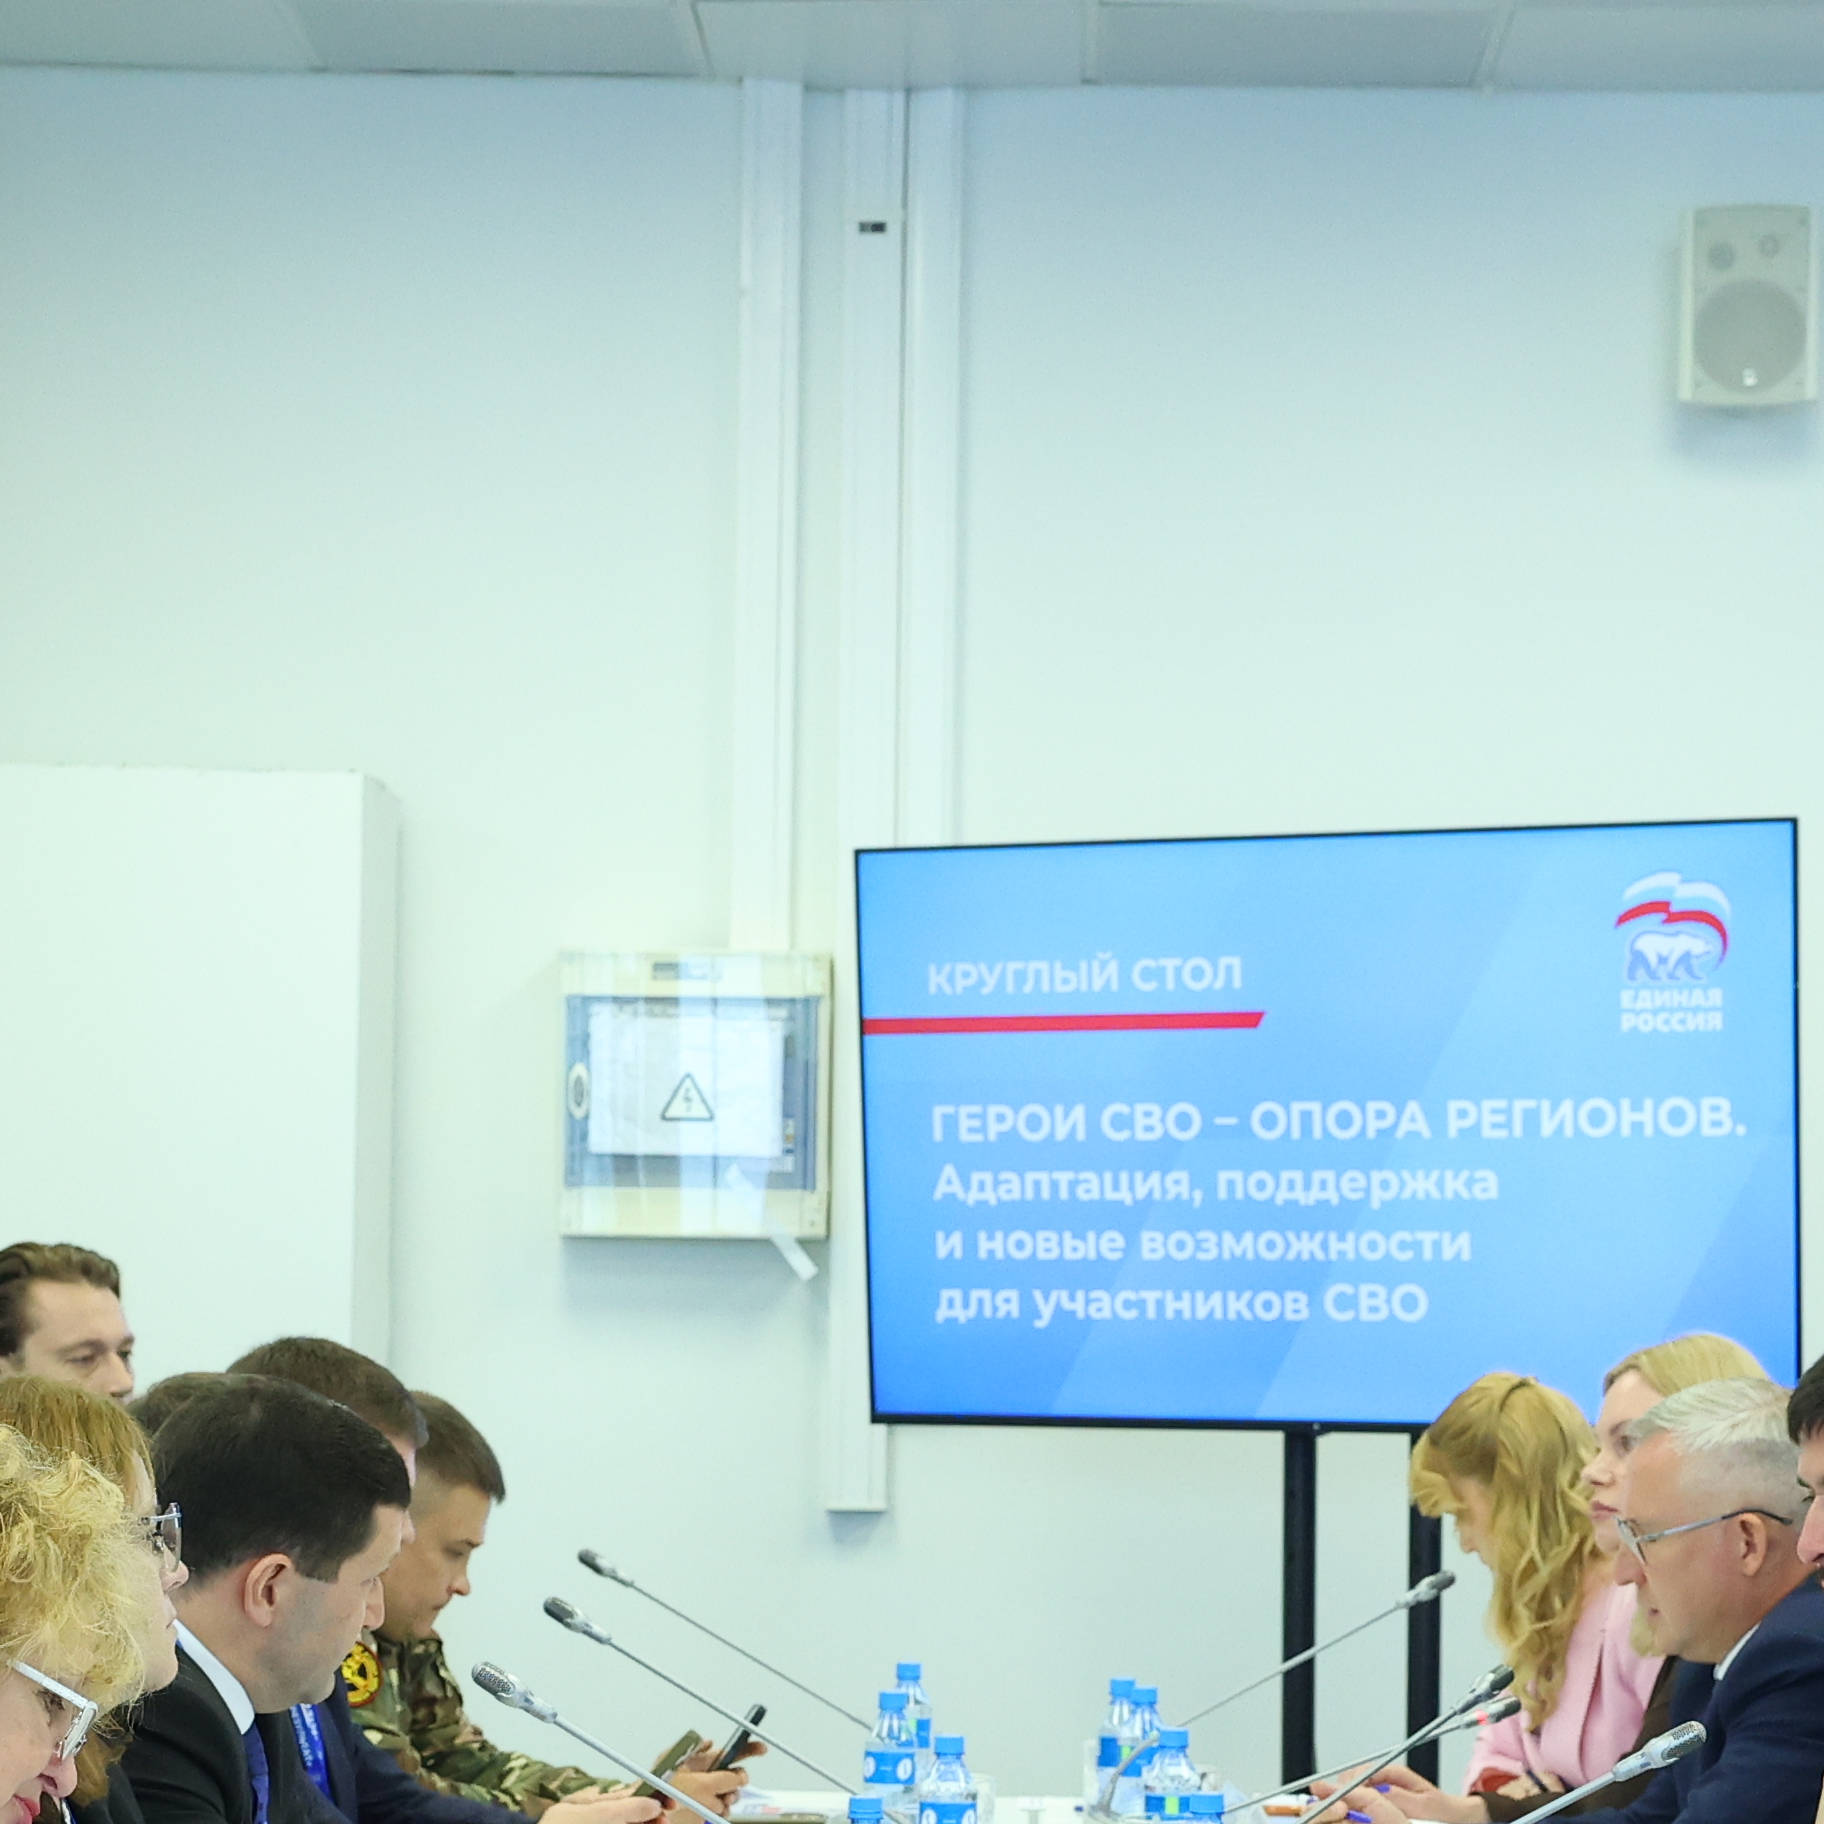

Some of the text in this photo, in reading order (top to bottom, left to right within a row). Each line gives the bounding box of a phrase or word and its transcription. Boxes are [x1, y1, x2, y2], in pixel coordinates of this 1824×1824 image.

[927, 953, 1242, 996] КРУГЛЫЙ СТОЛ
[1620, 987, 1723, 1011] ЕДИНАЯ
[1620, 1010, 1723, 1034] РОССИЯ
[932, 1103, 1087, 1143] ГЕРОИ
[1100, 1100, 1201, 1141] СВО
[1250, 1098, 1431, 1141] ОПОРА
[1446, 1096, 1747, 1140] РЕГИОНОВ.
[934, 1162, 1499, 1208] Адаптация, поддержка
[935, 1228, 1471, 1262] и новые возможности
[935, 1283, 1428, 1330] для участников СВО
